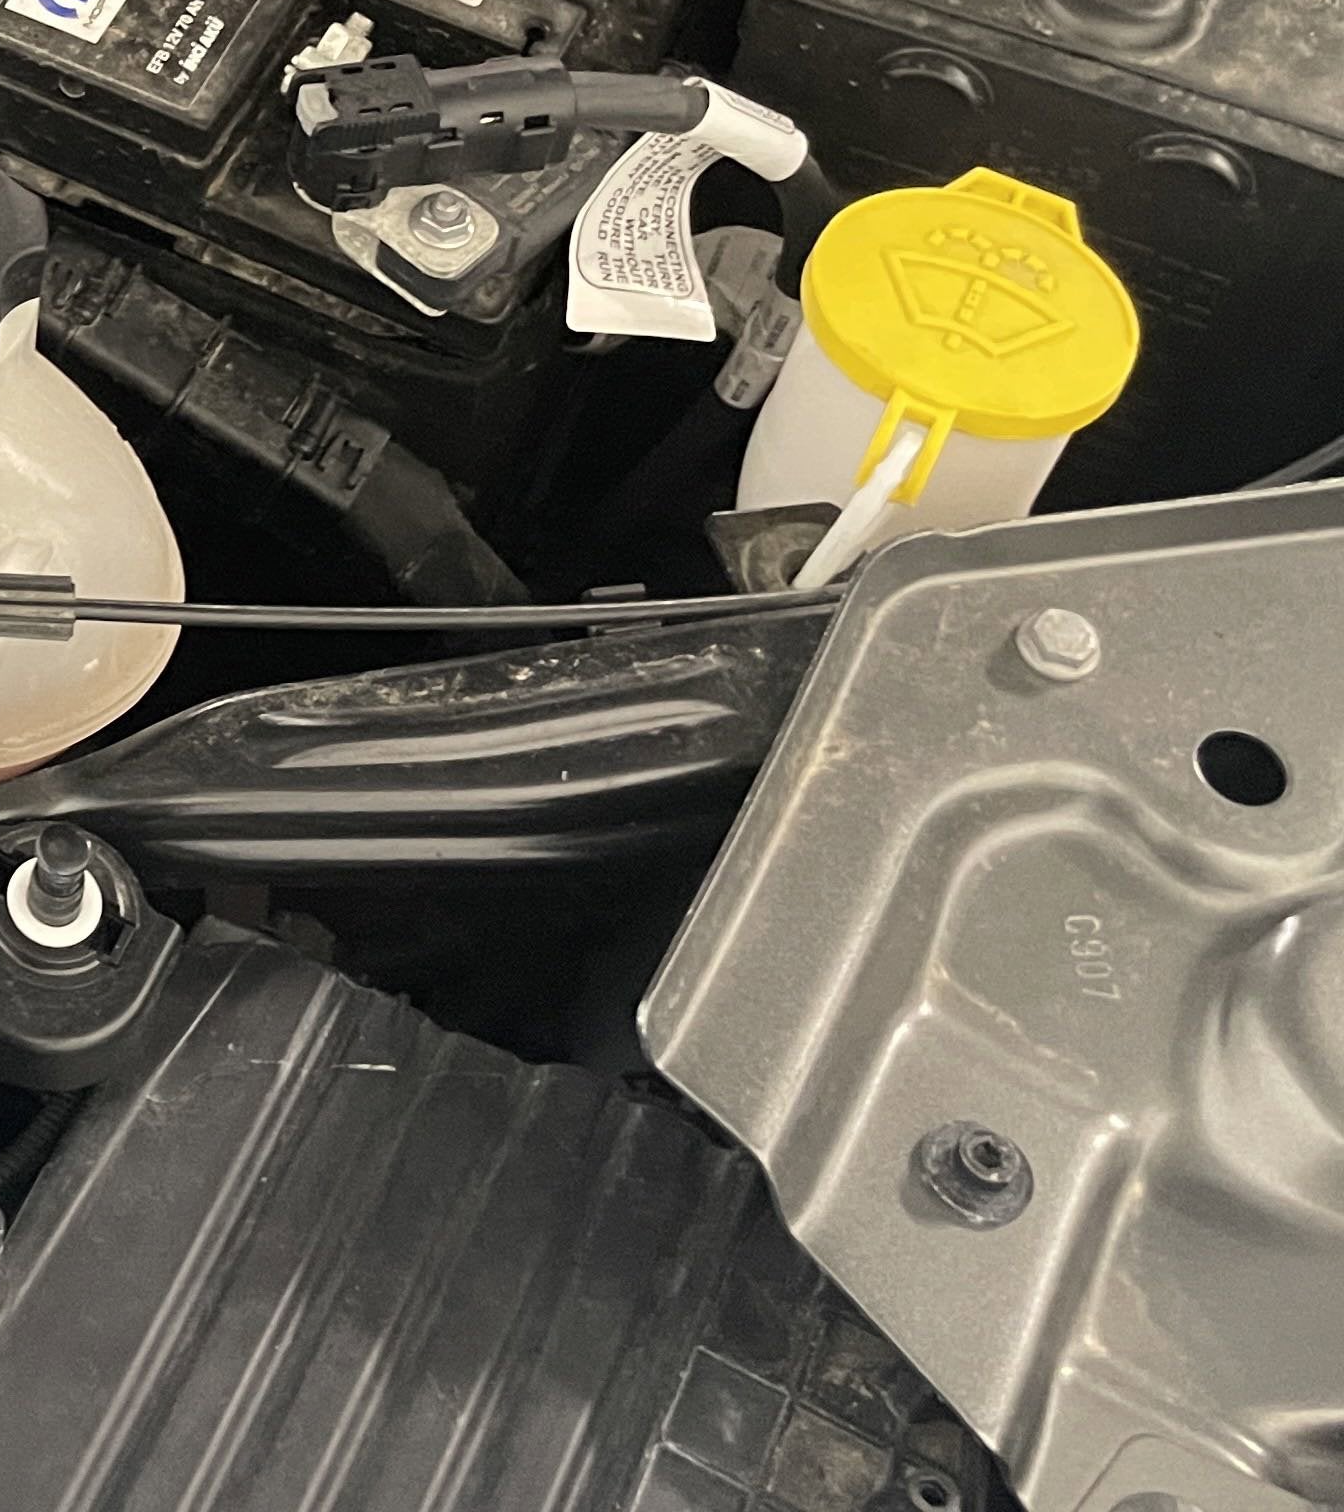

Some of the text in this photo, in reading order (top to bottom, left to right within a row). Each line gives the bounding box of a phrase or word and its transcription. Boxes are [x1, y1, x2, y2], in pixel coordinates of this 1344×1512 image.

[145, 49, 171, 76] EFB
[162, 28, 185, 53] 12V
[597, 187, 624, 241] COULD
[637, 207, 649, 242] CAR
[663, 169, 689, 293] RECONNECTING
[596, 250, 613, 282] RUN
[612, 257, 630, 284] THE
[623, 218, 644, 287] WITHOUT
[640, 259, 659, 289] FOR
[654, 253, 674, 293] TURN
[1064, 914, 1122, 1000] C907
